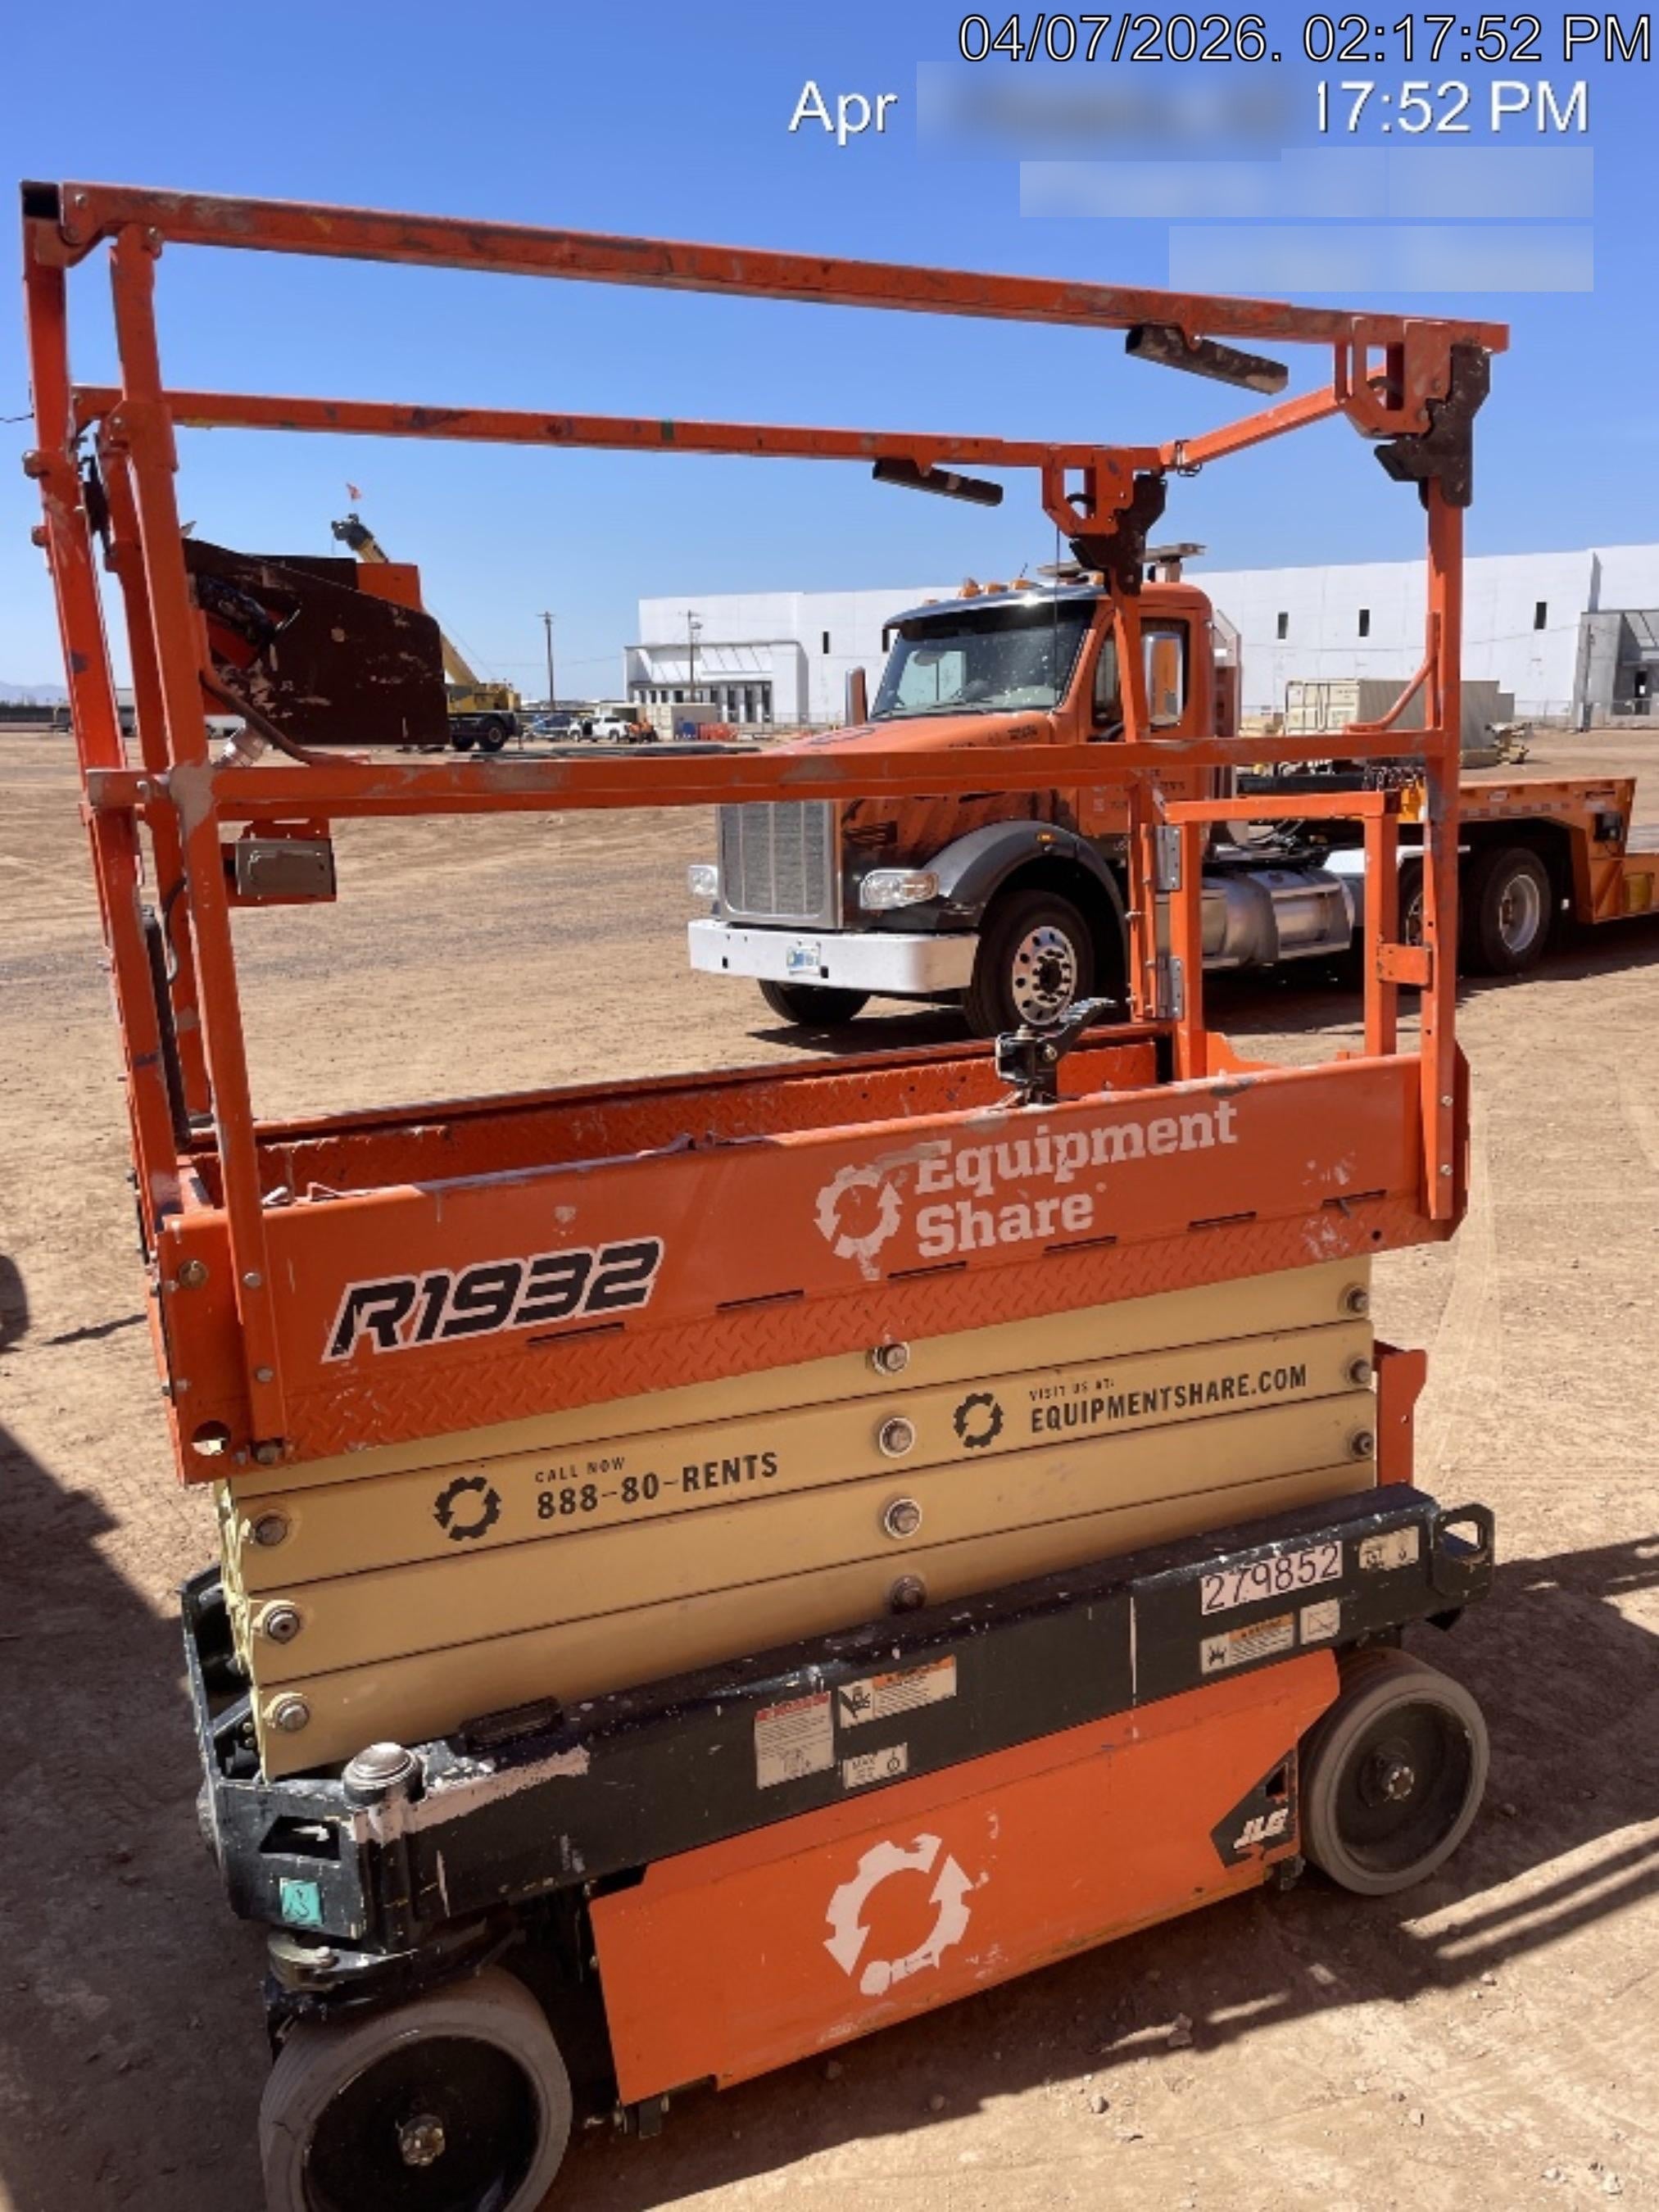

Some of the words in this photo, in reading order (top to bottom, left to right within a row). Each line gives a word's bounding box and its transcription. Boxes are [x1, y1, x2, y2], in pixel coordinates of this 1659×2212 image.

[914, 1100, 1238, 1198] Equipment
[916, 1191, 1094, 1258] Share
[323, 1236, 664, 1362] R1932
[1029, 1385, 1065, 1402] VISIT
[1072, 1380, 1087, 1394] US
[1031, 1364, 1307, 1433] EQUIPMENTSHARE.COM
[535, 1465, 578, 1483] CALL
[587, 1457, 626, 1475] NOW
[537, 1452, 778, 1520] 888-80-RENTS
[1204, 1543, 1339, 1611] 279852
[1233, 1807, 1289, 1849] JLG
